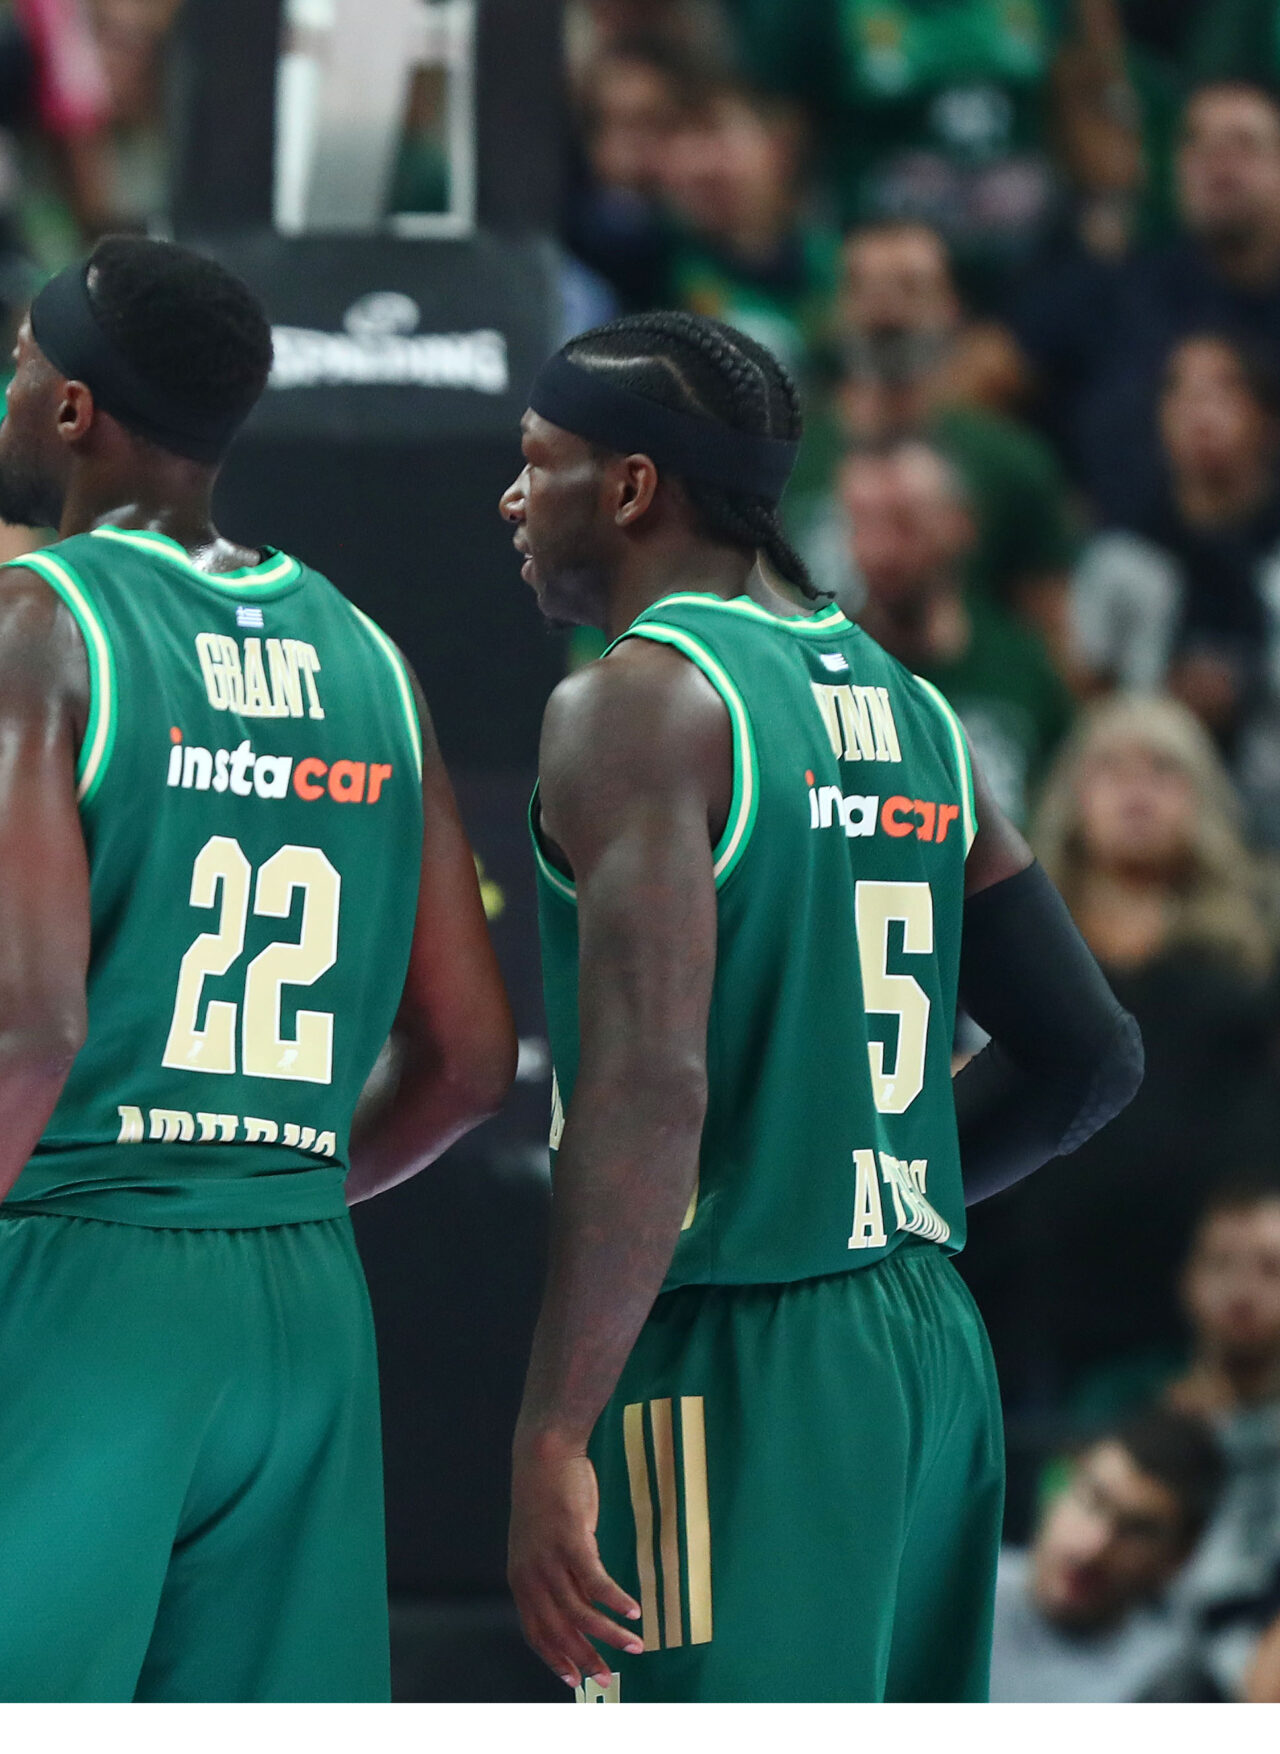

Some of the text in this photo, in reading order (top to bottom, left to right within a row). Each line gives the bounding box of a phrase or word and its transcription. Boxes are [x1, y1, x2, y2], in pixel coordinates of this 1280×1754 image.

[195, 633, 325, 720] GRANT
[167, 726, 393, 804] instacar
[161, 835, 342, 1085] 22
[855, 880, 933, 1114] 5
